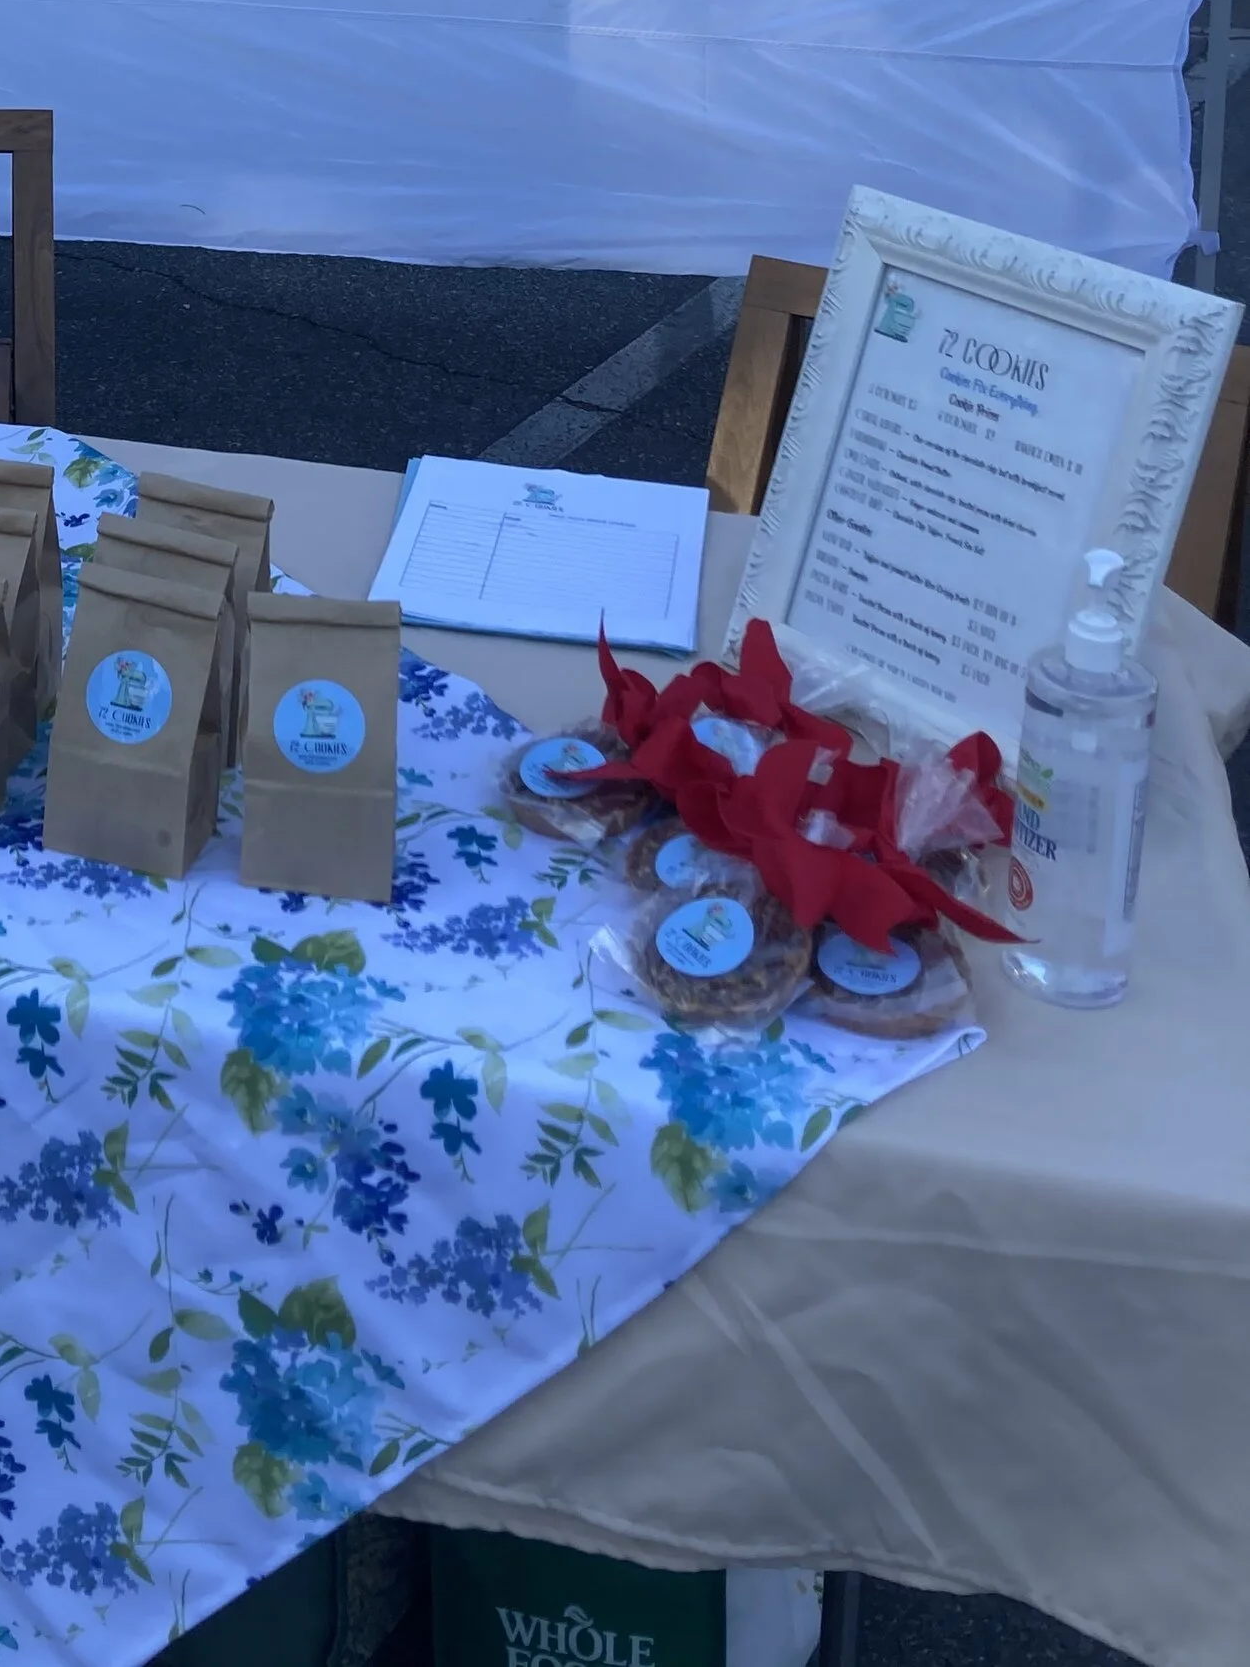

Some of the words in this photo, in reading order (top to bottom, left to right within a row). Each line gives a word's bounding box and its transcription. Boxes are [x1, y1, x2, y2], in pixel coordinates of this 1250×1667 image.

[938, 328, 959, 358] 72
[962, 337, 1049, 391] COOKIES
[495, 1605, 656, 1667] WHOLE
